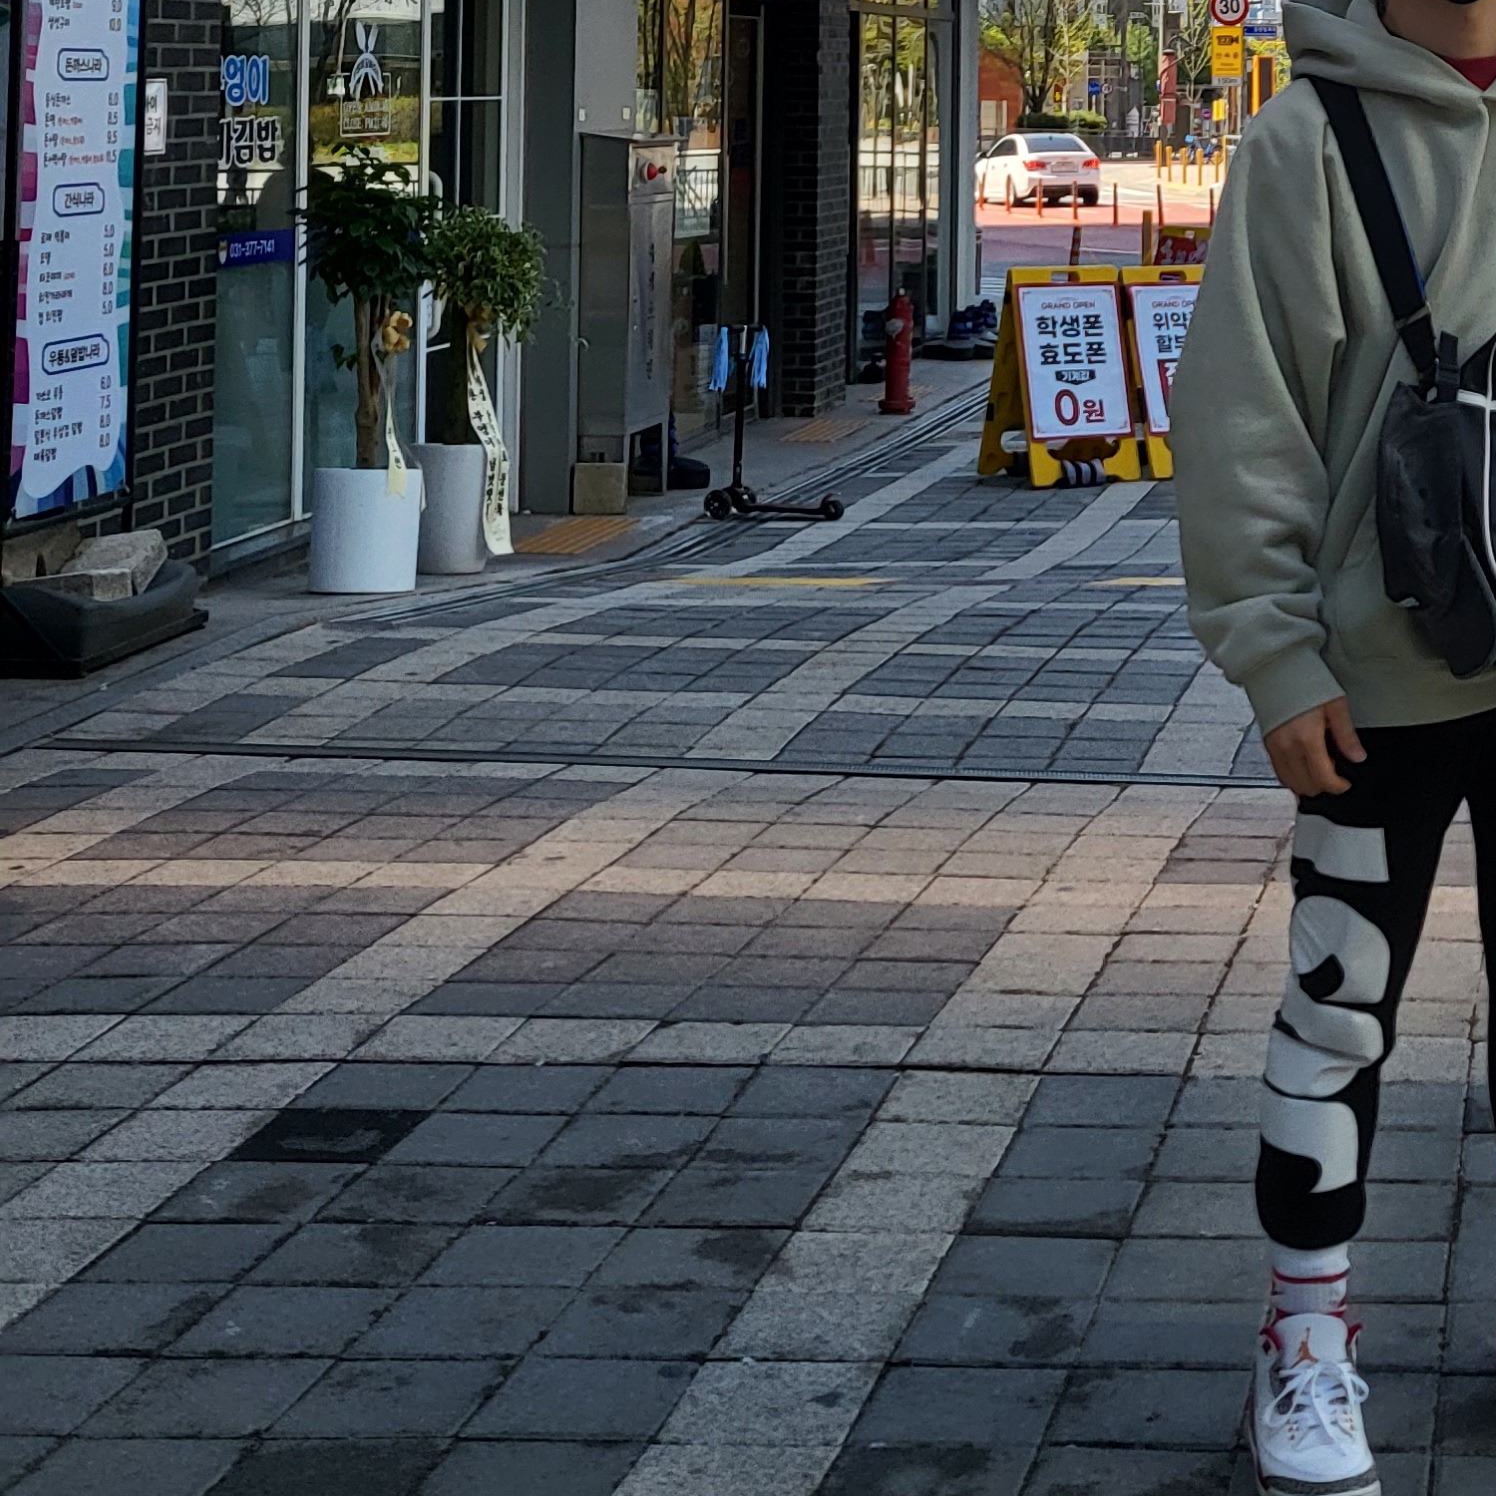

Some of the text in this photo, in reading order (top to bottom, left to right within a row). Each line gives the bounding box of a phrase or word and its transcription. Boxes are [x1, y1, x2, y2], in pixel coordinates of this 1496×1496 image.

[220, 55, 270, 106] 엉이
[229, 240, 275, 258] 031-377-7141
[1041, 301, 1096, 310] GRAND OPEN
[1151, 300, 1181, 308] GRAND
[1036, 314, 1104, 339] 학생폰
[1040, 341, 1108, 366] 효도폰
